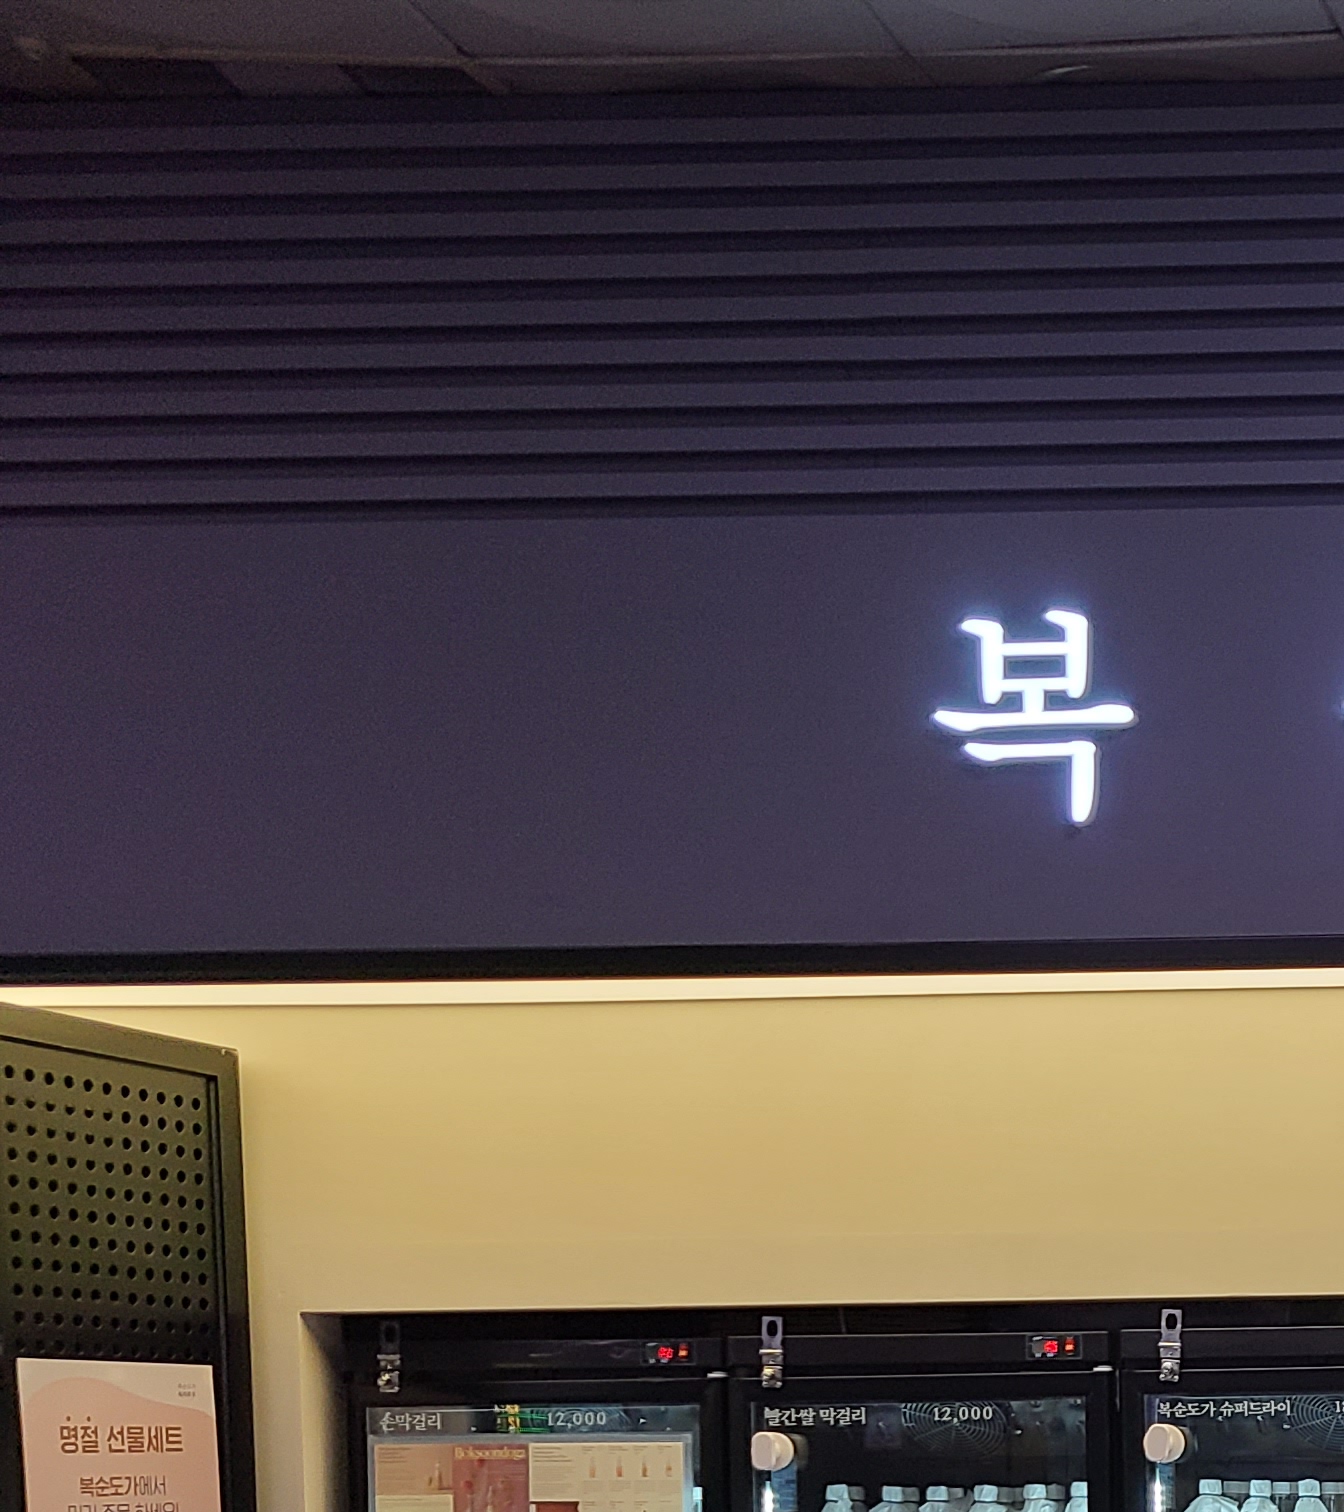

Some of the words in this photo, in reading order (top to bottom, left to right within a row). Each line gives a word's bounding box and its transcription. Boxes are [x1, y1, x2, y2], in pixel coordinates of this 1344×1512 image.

[764, 1406, 816, 1427] 빨간쌀
[819, 1406, 867, 1426] 막걸리
[933, 1406, 993, 1423] 12,000
[1157, 1401, 1216, 1419] 복순도가
[1219, 1400, 1291, 1417] 슈퍼드라이
[379, 1412, 442, 1431] 손막걸리
[547, 1412, 606, 1429] 12,000
[60, 1424, 100, 1454] 명절
[107, 1425, 184, 1454] 선물세트
[80, 1476, 167, 1498] 복순도가에서
